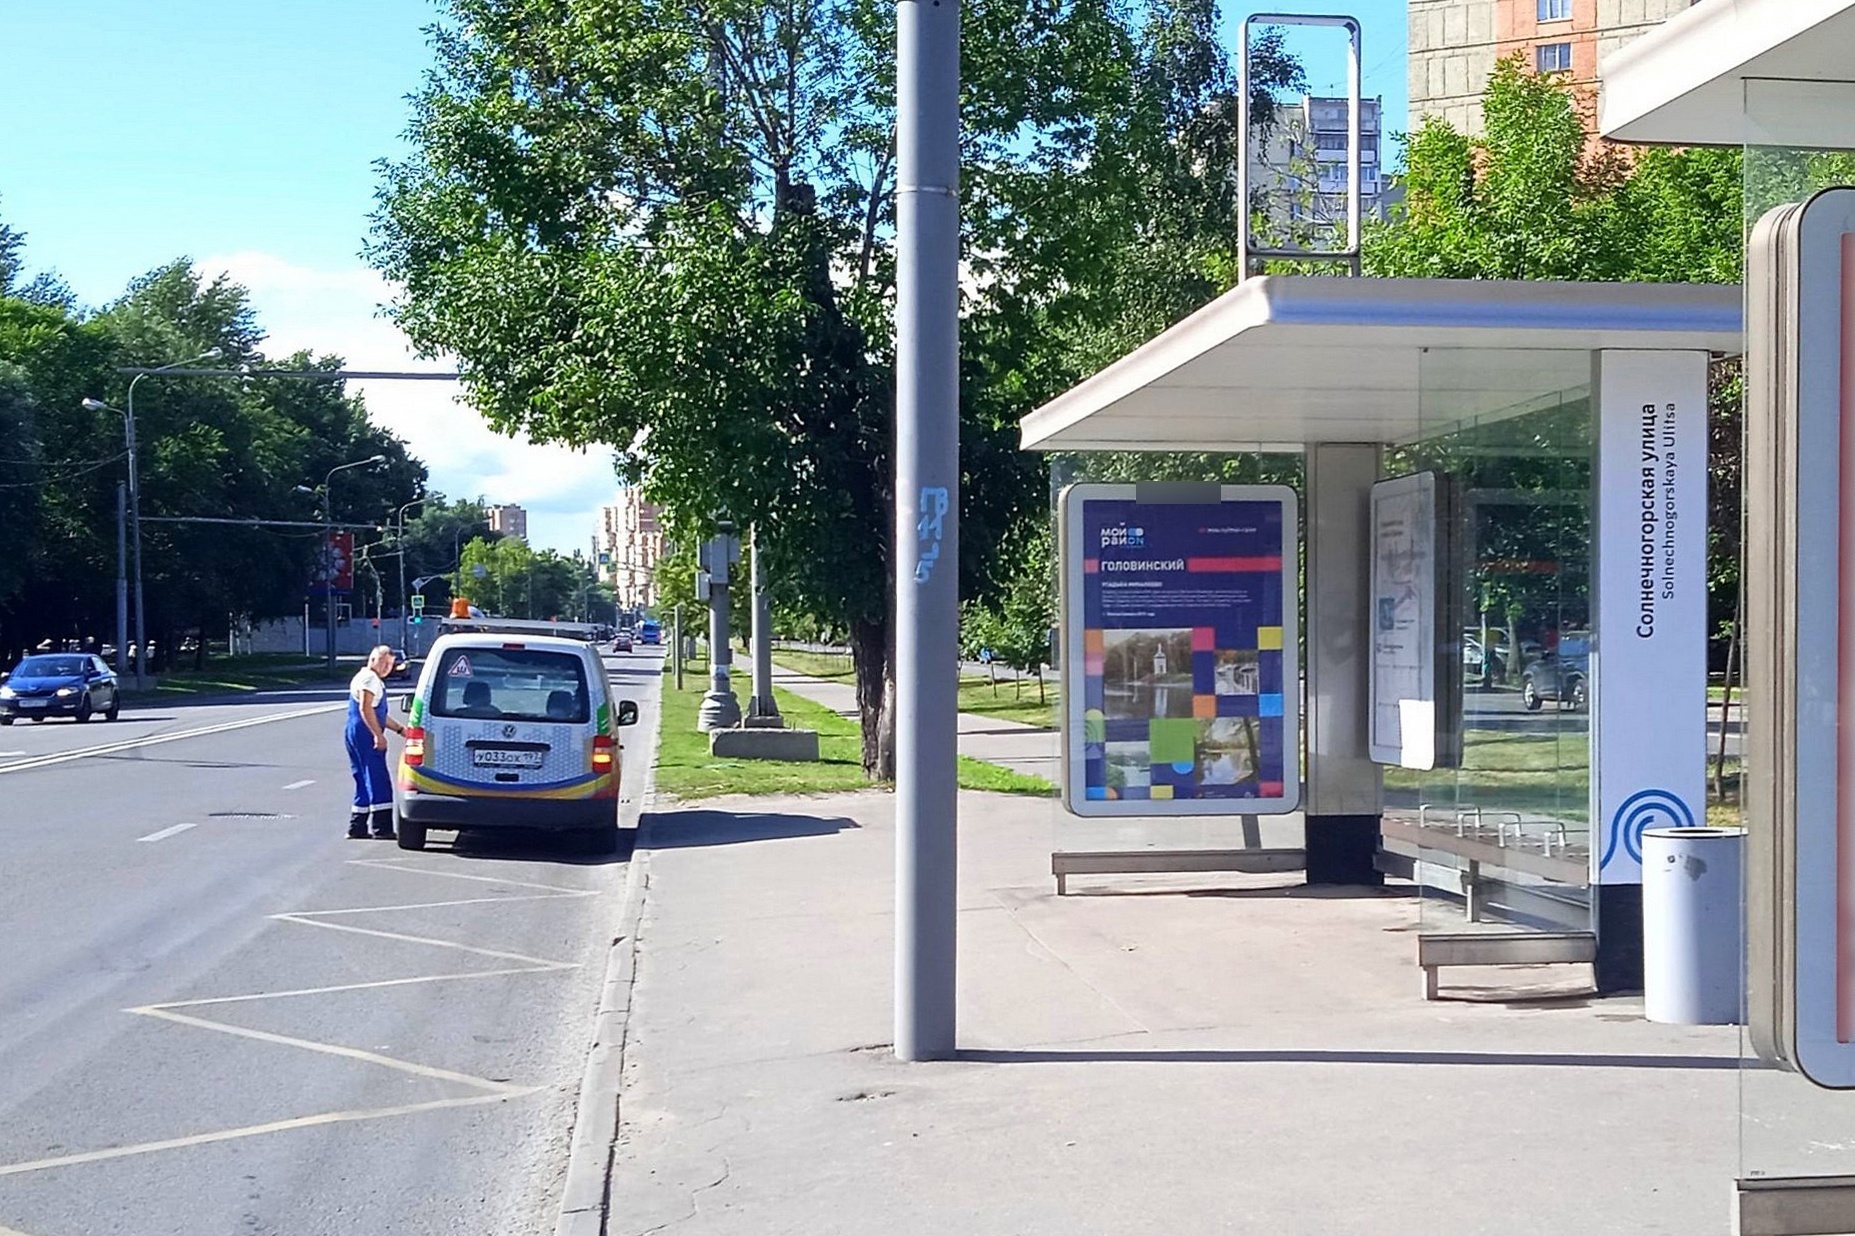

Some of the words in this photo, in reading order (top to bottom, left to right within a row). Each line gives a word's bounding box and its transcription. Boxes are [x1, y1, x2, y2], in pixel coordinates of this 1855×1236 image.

[1641, 404, 1659, 461] улица
[1663, 403, 1675, 447] Ulitsa
[1636, 467, 1658, 638] Солнечногорская
[1662, 452, 1678, 600] Solnechnogorskaya
[1101, 558, 1185, 571] ГОЛОВИНСКИЙ
